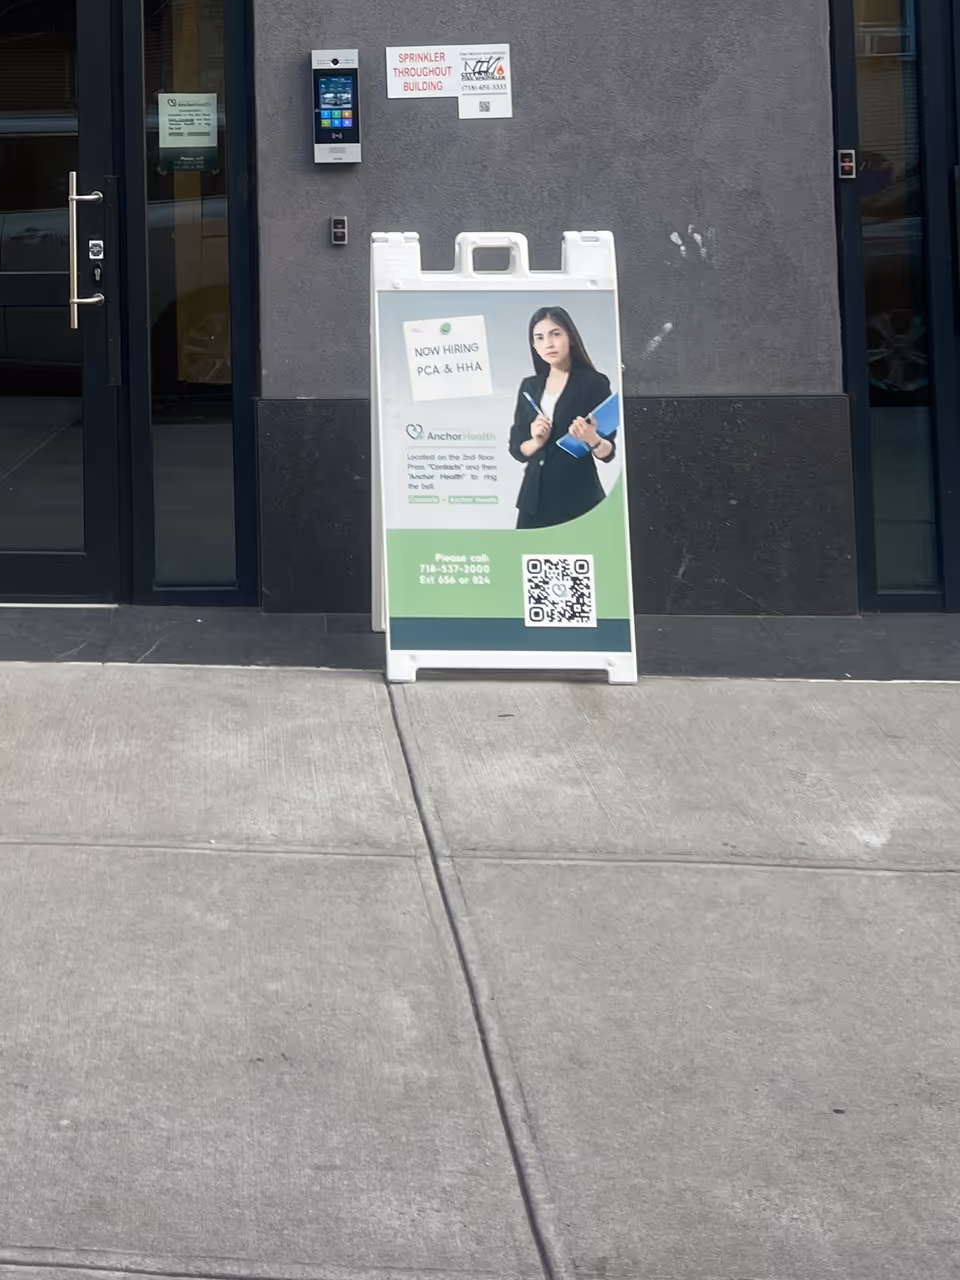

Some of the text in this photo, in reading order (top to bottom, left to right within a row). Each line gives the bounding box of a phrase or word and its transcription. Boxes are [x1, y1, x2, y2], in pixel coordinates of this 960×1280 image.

[398, 52, 446, 63] SPRINKLER
[393, 66, 452, 78] THROUGHOUT
[403, 81, 443, 92] BUILDING
[414, 342, 479, 357] NOW HIRING
[416, 361, 483, 376] PCA & HHA
[407, 453, 435, 461] Located
[448, 453, 460, 461] the
[462, 453, 476, 461] 2nd
[465, 463, 480, 471] and
[481, 463, 497, 471] then
[483, 474, 498, 482] ring
[435, 553, 467, 562] Please
[419, 564, 490, 574] 718-537-2000
[419, 575, 435, 584] Ext
[437, 575, 456, 584] 656
[472, 575, 491, 585] 824
